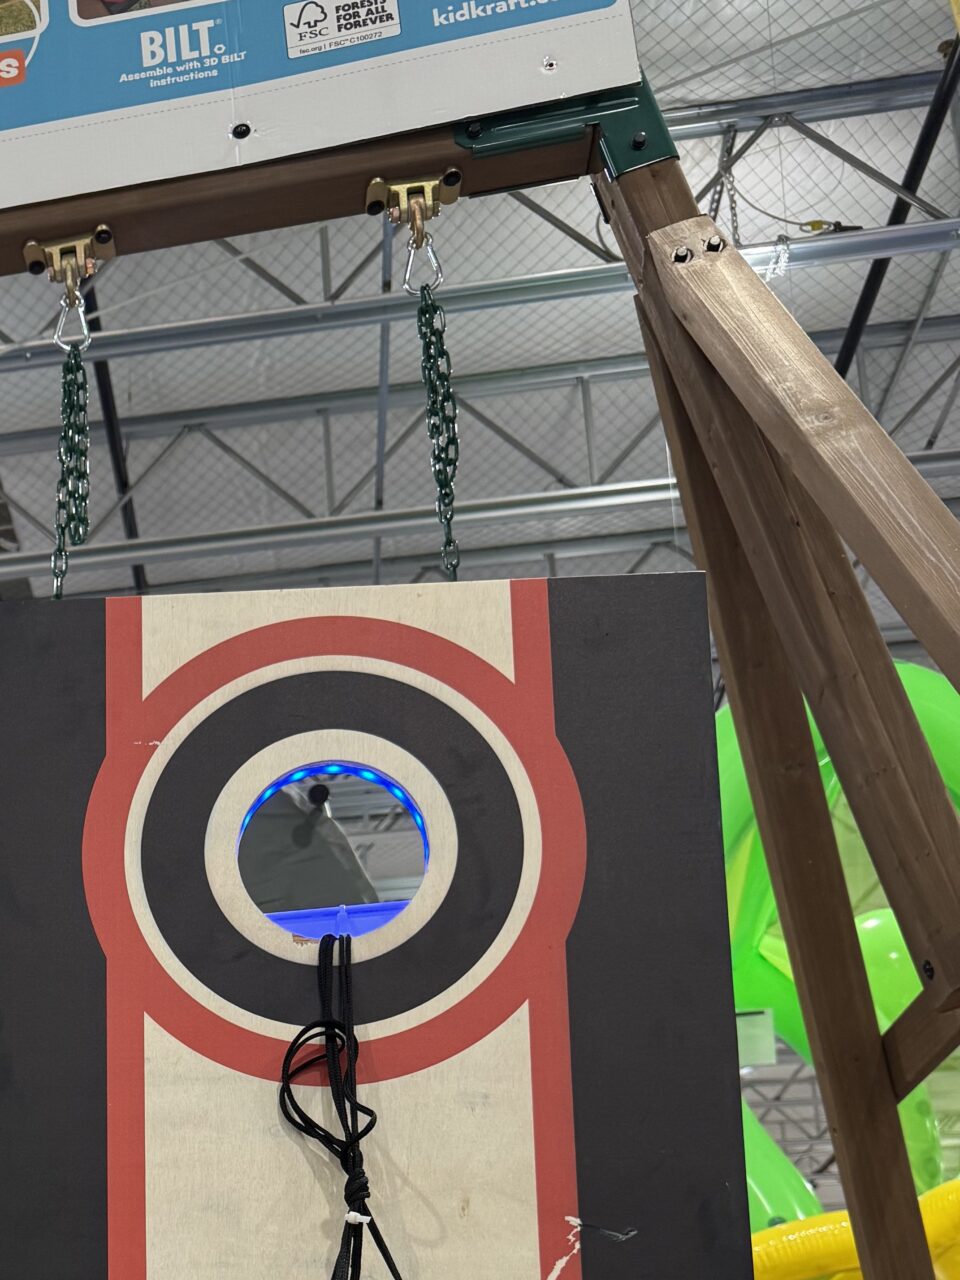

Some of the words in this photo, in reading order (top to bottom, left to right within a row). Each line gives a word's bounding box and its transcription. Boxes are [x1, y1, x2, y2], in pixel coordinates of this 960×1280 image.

[336, 11, 361, 23] FOR
[365, 5, 388, 17] ALL
[337, 13, 394, 32] FOREVER
[298, 27, 329, 41] FSC
[119, 67, 173, 83] Assemble
[176, 61, 201, 72] with
[203, 57, 219, 67] 3D
[221, 51, 247, 64] BILT
[149, 69, 218, 88] instructions
